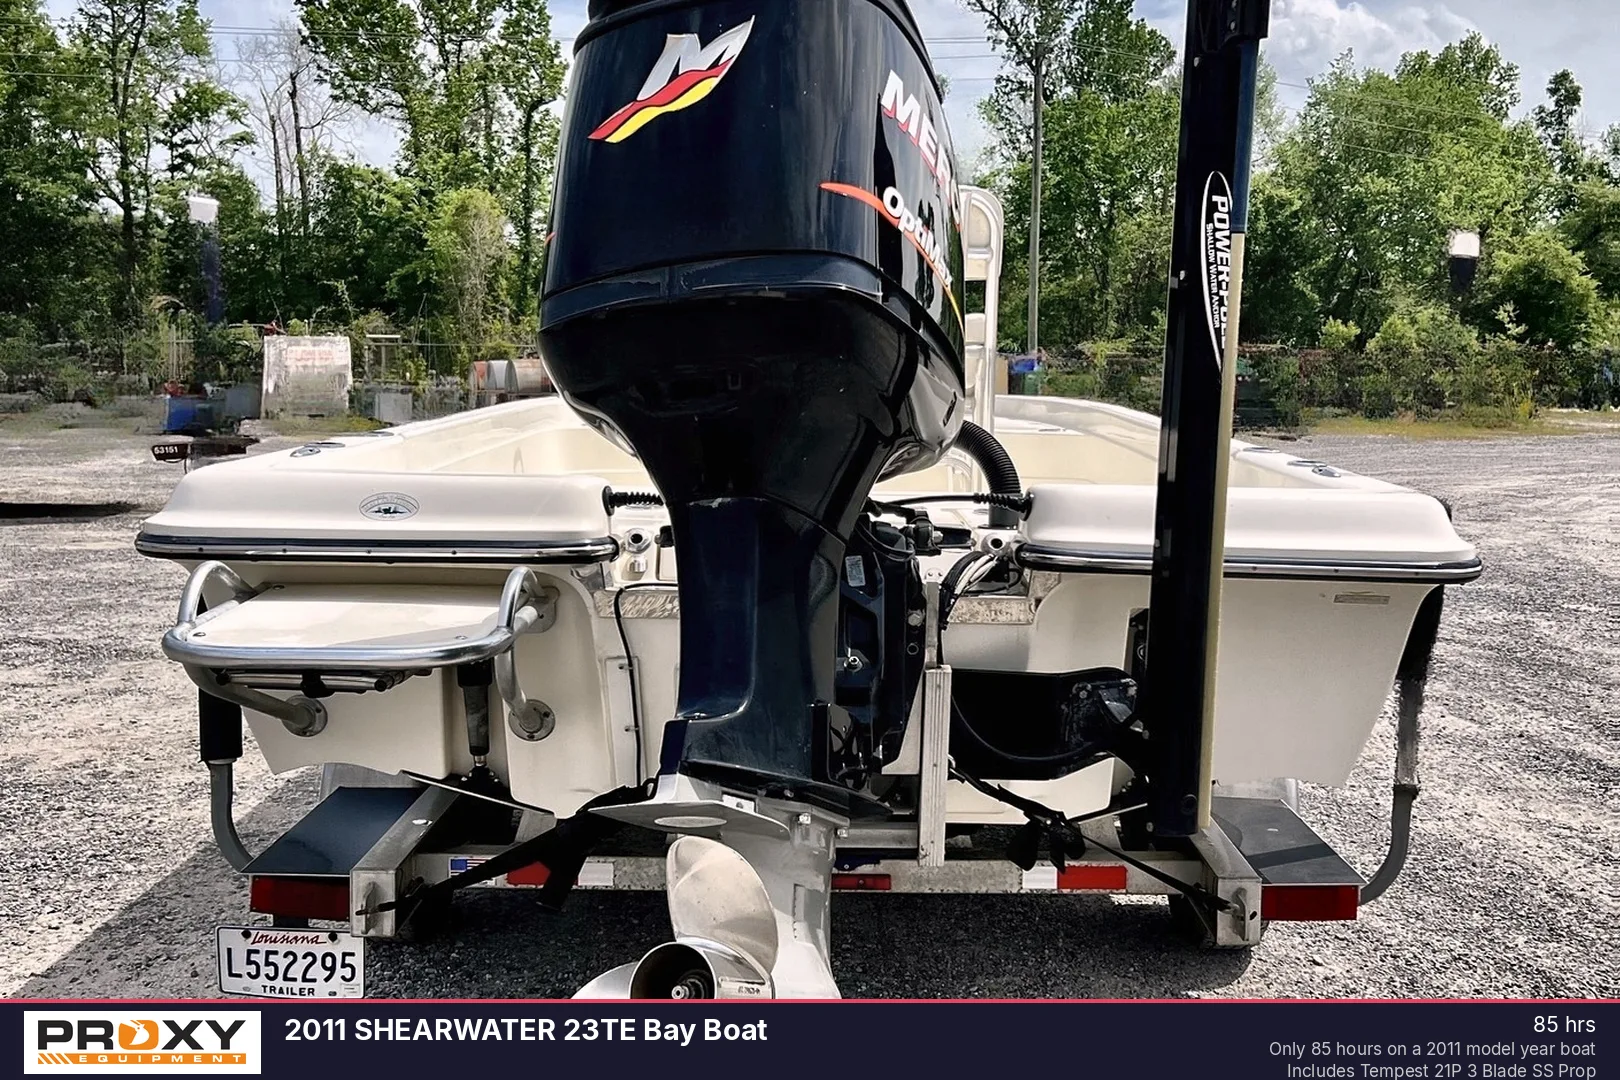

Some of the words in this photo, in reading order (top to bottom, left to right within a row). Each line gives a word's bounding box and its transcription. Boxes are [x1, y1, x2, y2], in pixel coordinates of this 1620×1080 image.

[1206, 223, 1215, 263] SHALLOW
[1209, 264, 1218, 293] WATER
[1212, 295, 1220, 328] ANCHOR
[251, 932, 327, 945] Louisiana
[227, 947, 356, 983] L552295
[262, 985, 315, 996] TRAILER
